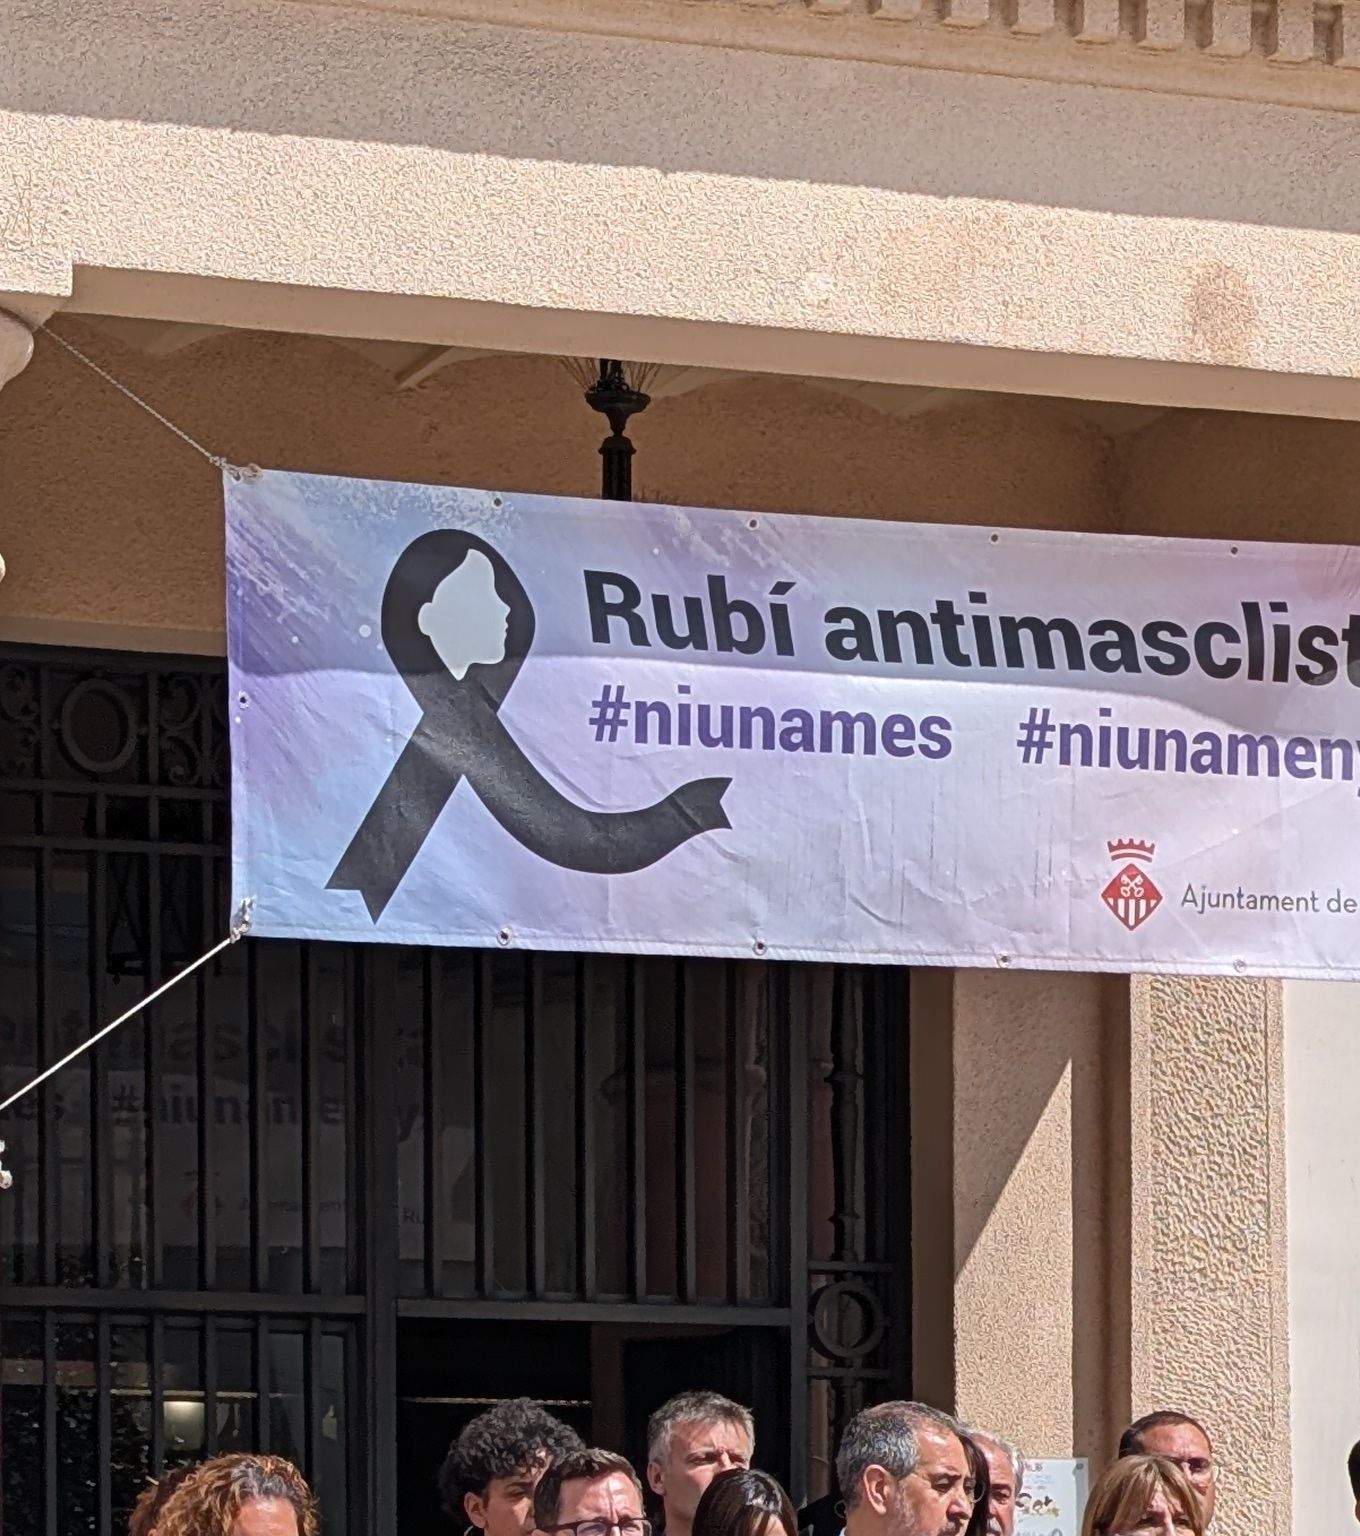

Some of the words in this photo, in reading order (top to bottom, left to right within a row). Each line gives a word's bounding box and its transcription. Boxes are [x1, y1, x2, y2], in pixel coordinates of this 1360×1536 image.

[583, 569, 795, 656] Rubí
[589, 684, 952, 760] #niunames
[1180, 882, 1320, 915] Ajuntament
[1326, 887, 1358, 914] de
